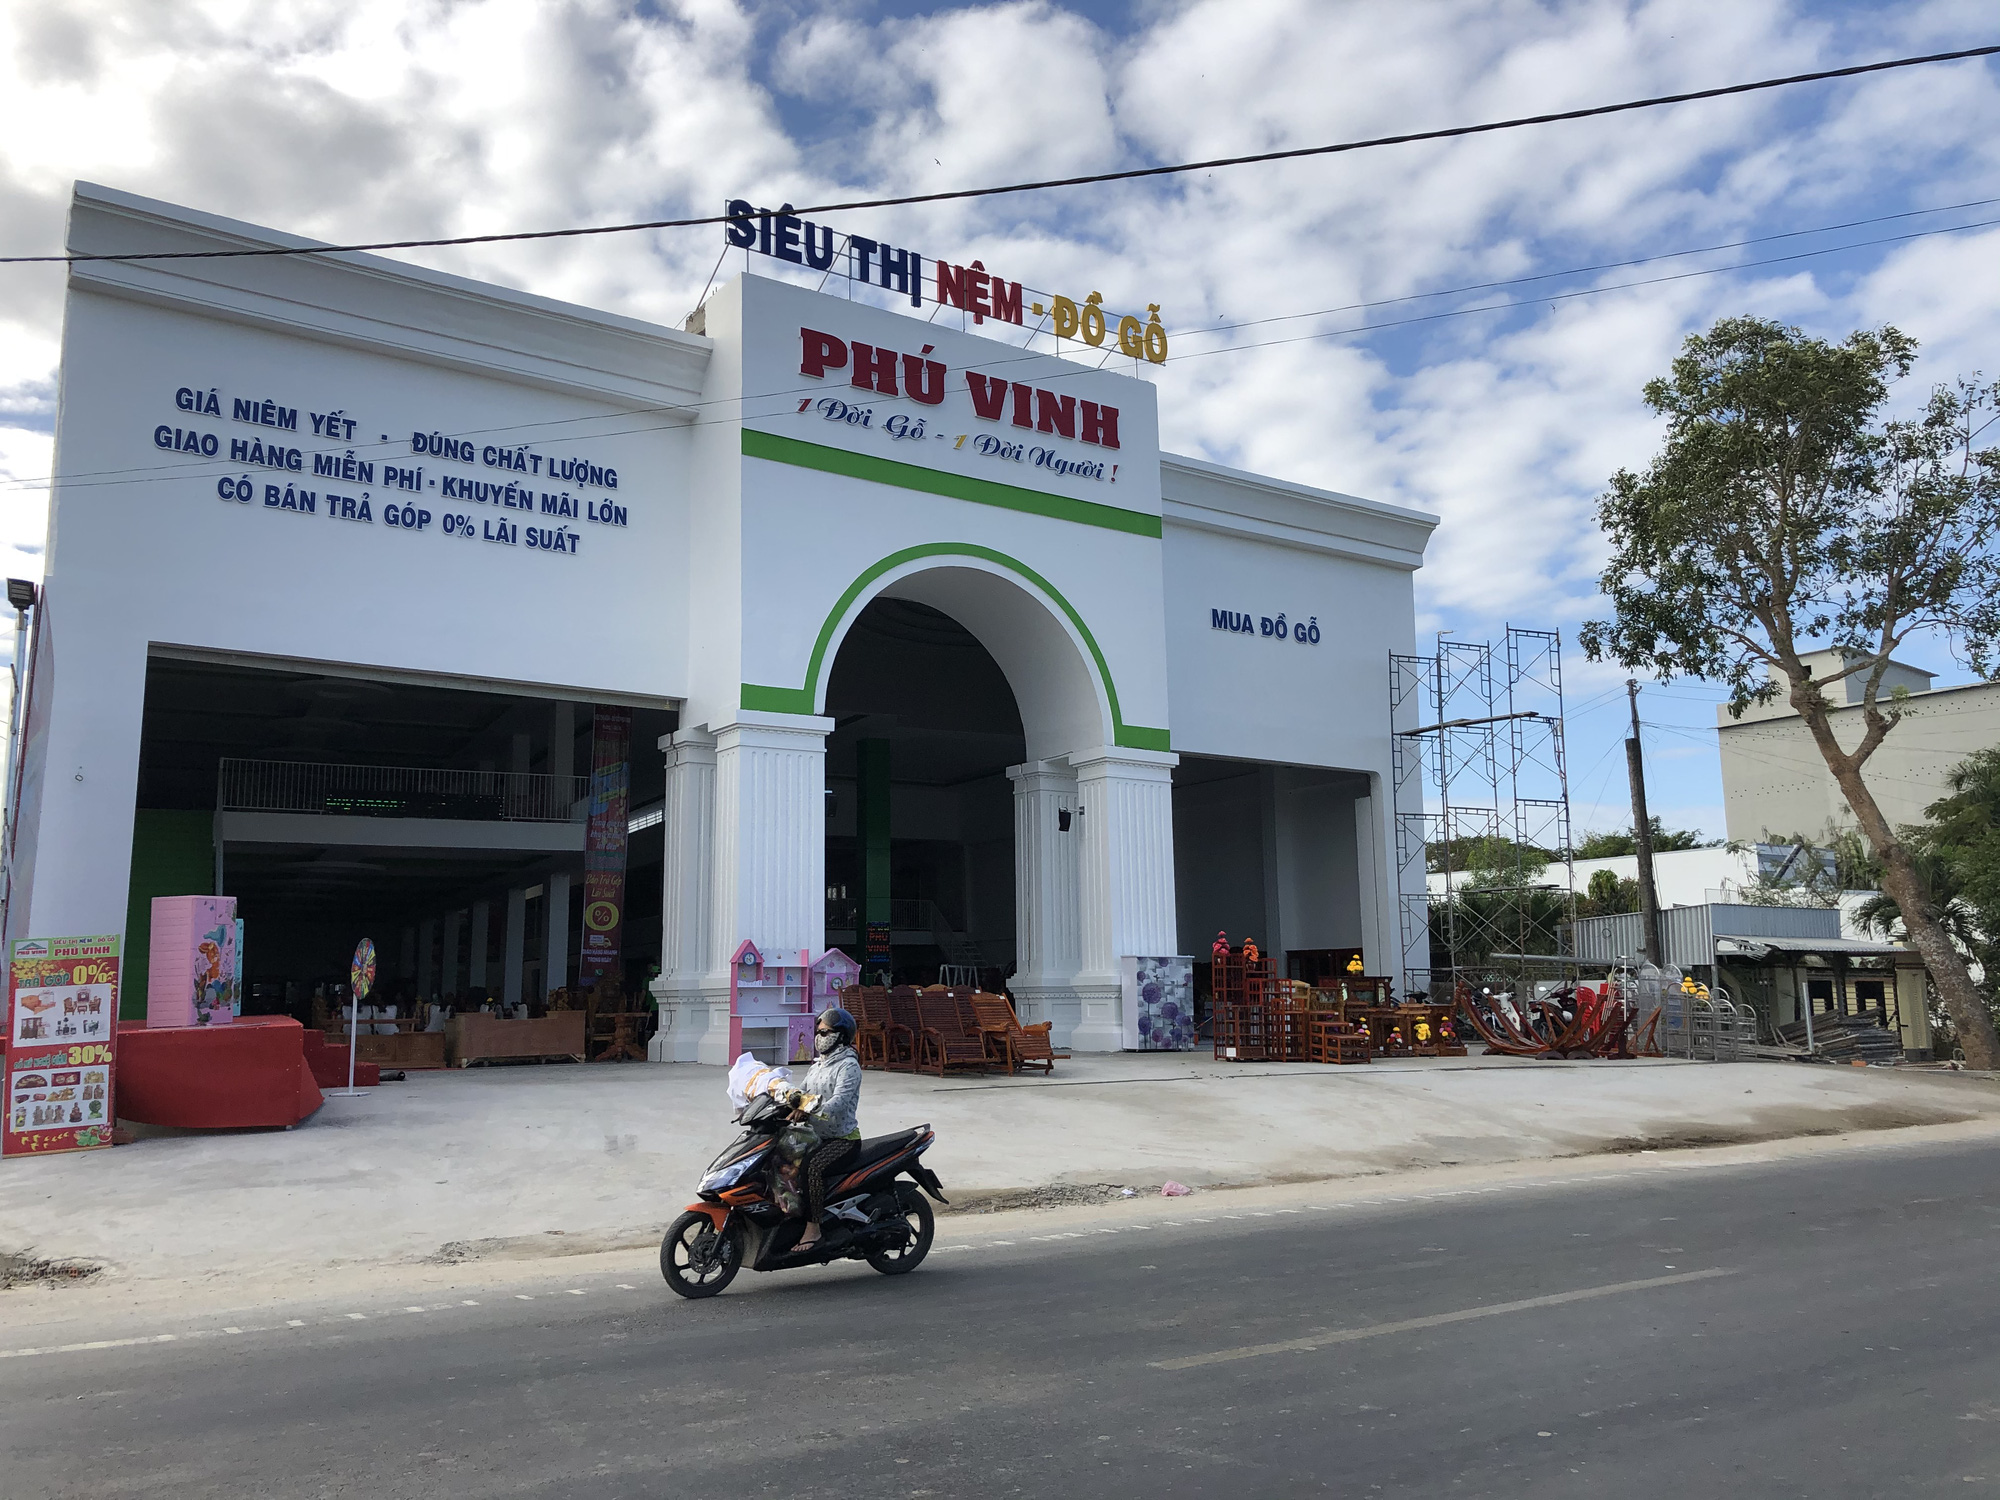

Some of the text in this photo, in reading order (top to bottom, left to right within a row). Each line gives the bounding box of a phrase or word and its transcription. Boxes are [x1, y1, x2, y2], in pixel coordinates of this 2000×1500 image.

[728, 199, 833, 271] SIÊU
[851, 234, 921, 308] THỊ
[937, 259, 1023, 325] NỆM
[1052, 290, 1106, 347] ĐỒ
[1118, 303, 1168, 364] GỖ
[799, 327, 1121, 450] PHÚ VINH
[154, 425, 219, 458] GIAO
[229, 437, 303, 473] HÀNG
[312, 450, 374, 484] MIỄN
[383, 465, 423, 492] PHÍ
[441, 475, 533, 511] KHUYẾN
[540, 492, 579, 519] MÃI
[587, 499, 628, 527] LỚN
[175, 387, 222, 418] GIÁ
[232, 398, 298, 431] NIÊM
[309, 409, 358, 441] YẾT
[411, 431, 475, 463] ĐÚNG
[482, 445, 543, 475] CHẤT
[548, 457, 618, 490] LƯỢNG
[796, 397, 812, 414] 1
[817, 397, 873, 430] Đời
[882, 414, 928, 441] Gỗ
[953, 434, 968, 450] 1
[974, 433, 1025, 463] Đời
[1029, 446, 1104, 482] Người
[217, 474, 580, 554] CÓ BÁN TRẢ GÓP 0% LÃI SUẤT
[1211, 608, 1321, 646] MUA ĐỒ GỖ
[73, 962, 108, 984] 0%
[82, 946, 110, 955] VINH
[68, 1044, 113, 1065] 30%
